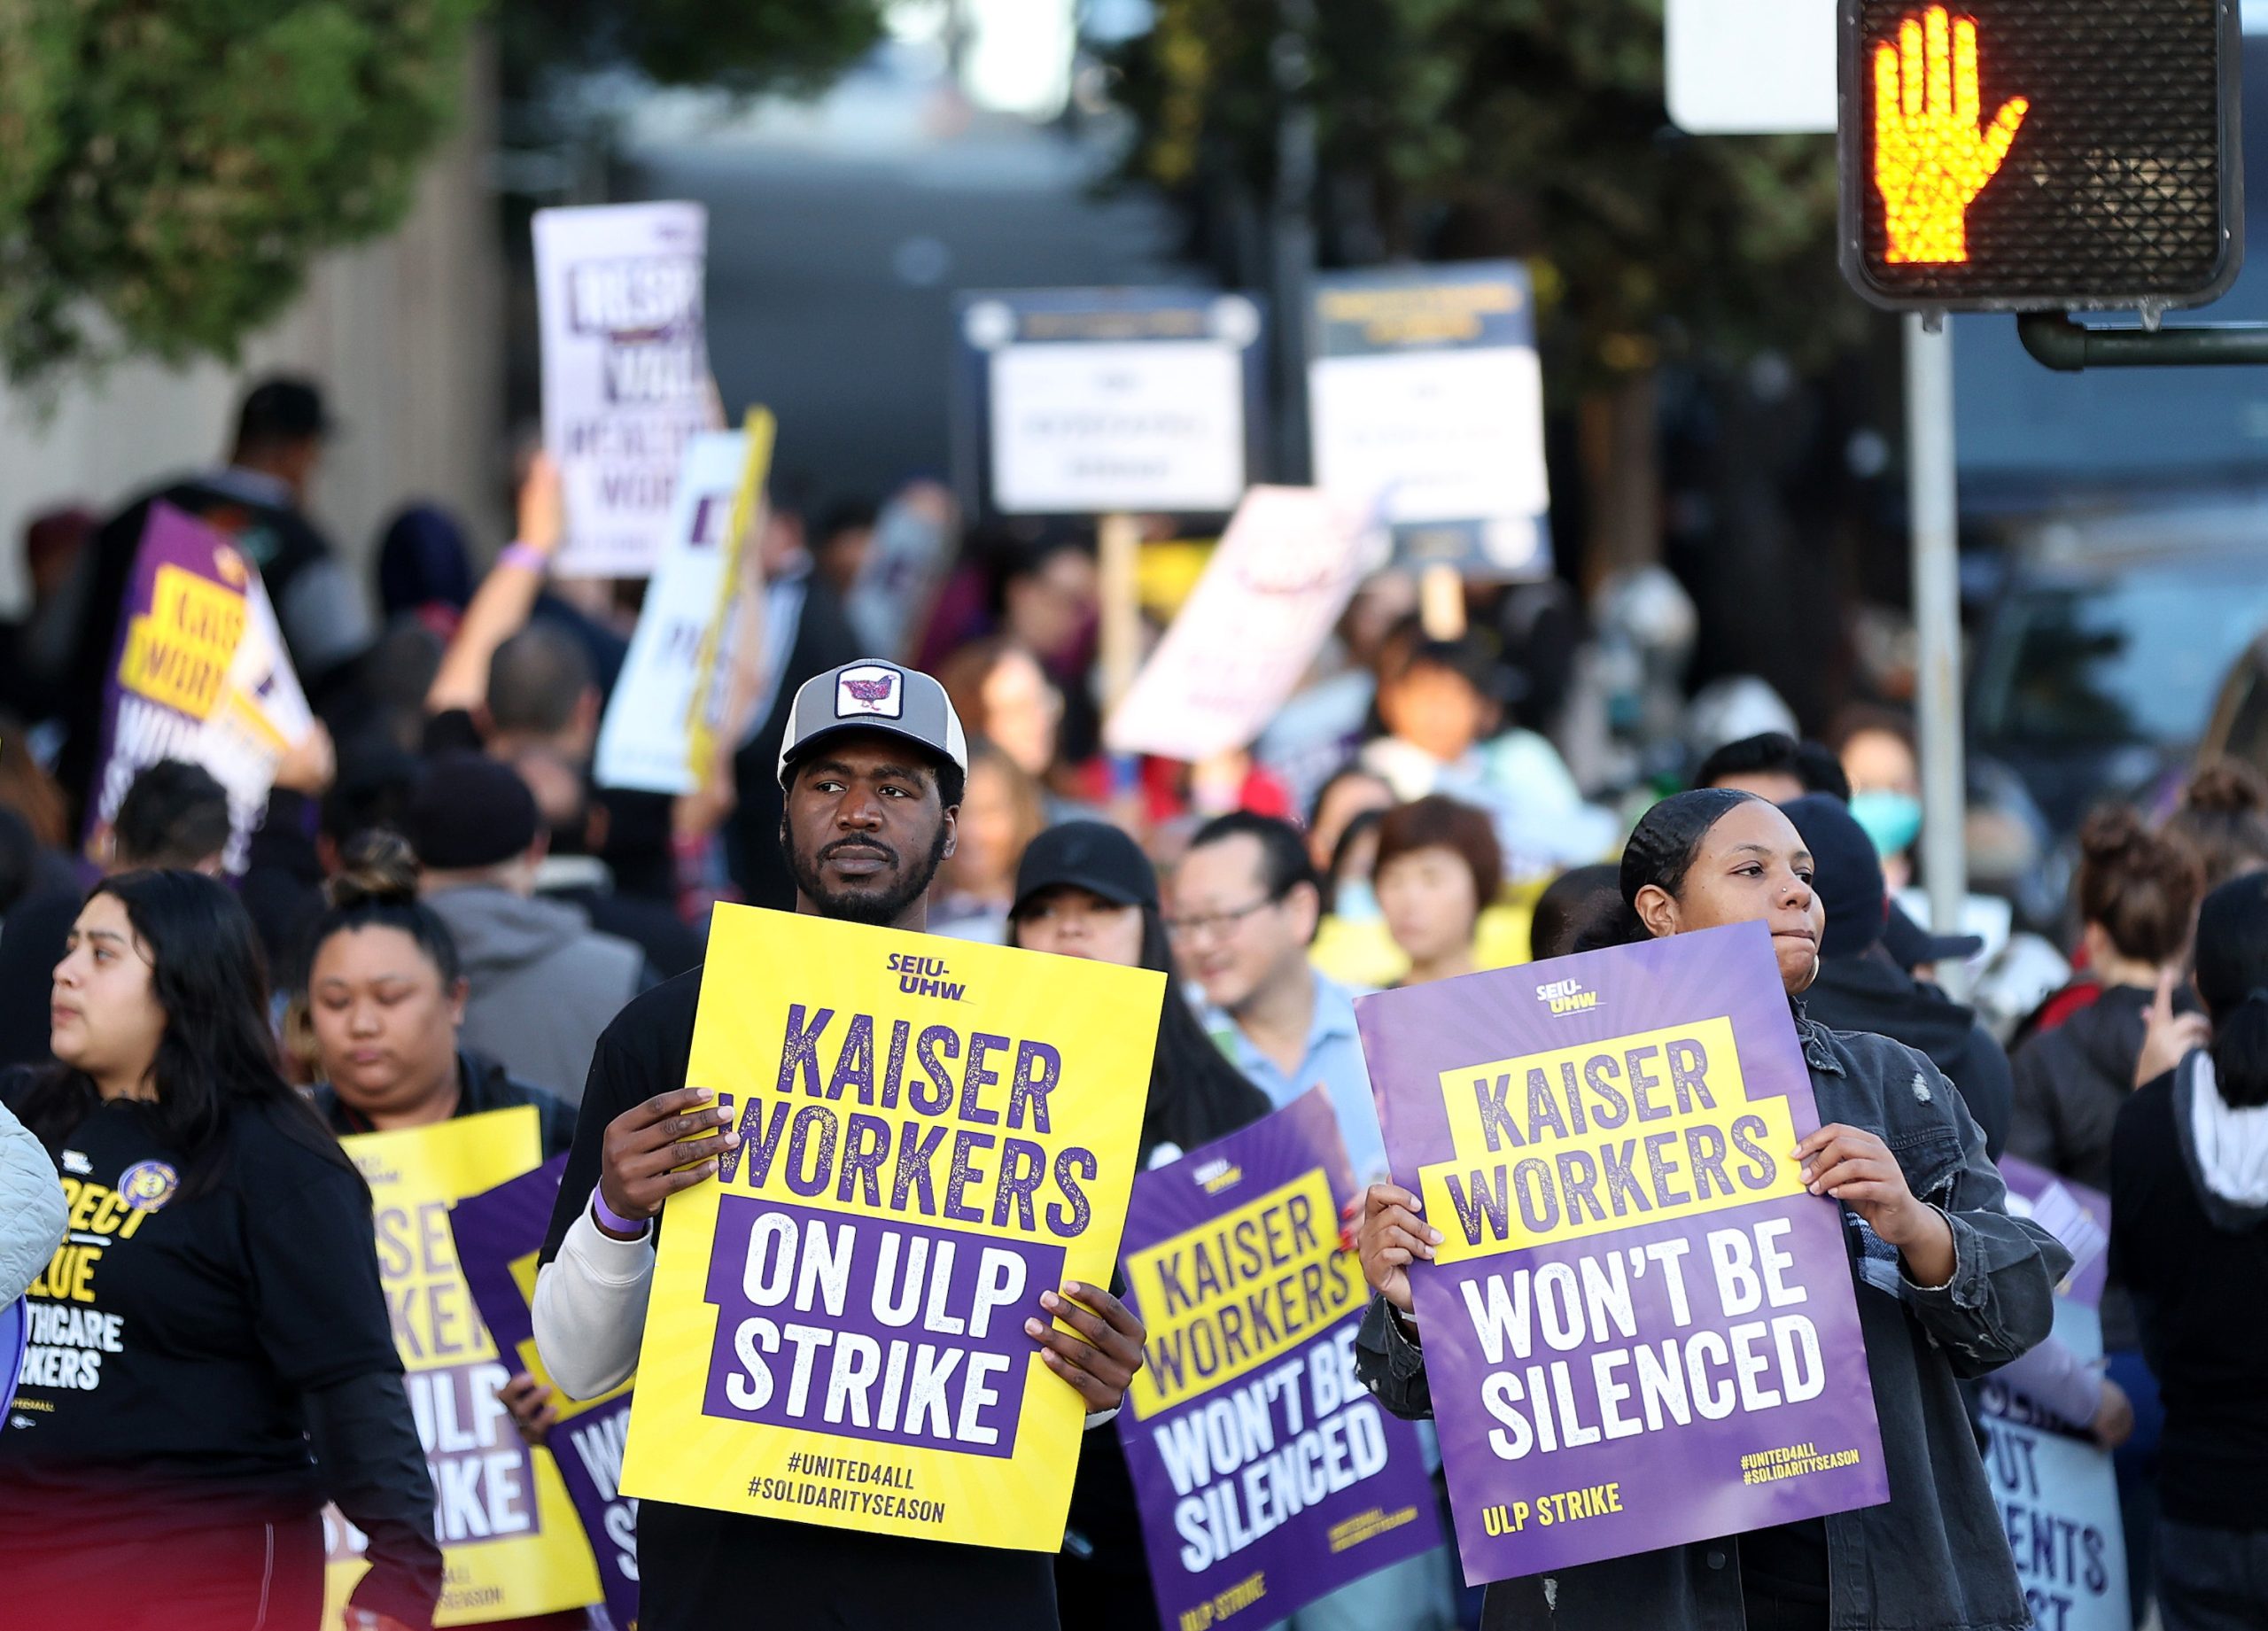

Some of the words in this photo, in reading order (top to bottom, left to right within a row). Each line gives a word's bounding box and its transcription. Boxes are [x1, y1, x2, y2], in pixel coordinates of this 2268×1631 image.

[887, 953, 950, 977] SEIU-
[899, 975, 966, 1001] UHW
[1535, 979, 1582, 1001] SEIU-
[1550, 991, 1596, 1014] UHW
[775, 1003, 1062, 1134] KAISER
[1473, 1037, 1718, 1152] KAISER
[718, 1092, 1097, 1238] WORKERS
[1445, 1115, 1777, 1246] WORKERS
[742, 1211, 857, 1317] ON
[871, 1231, 1027, 1339] ULP
[1157, 1192, 1319, 1318] KAISER
[1459, 1238, 1691, 1364] WON'T
[1705, 1217, 1808, 1316] BE
[725, 1316, 1011, 1445] STRIKE
[1143, 1262, 1352, 1398] WORKERS
[1481, 1314, 1826, 1461] SILENCED
[787, 1452, 915, 1490] #UNITED4ALL
[1154, 1358, 1304, 1495] WON'T
[1308, 1323, 1370, 1416] BE
[1740, 1442, 1818, 1471] #UNITED4ALL
[1743, 1448, 1860, 1486] #SOLIDARITYSEASON
[747, 1476, 945, 1524] #SOLIDARITYSEASON
[1174, 1402, 1388, 1573] SILENCED
[1483, 1503, 1529, 1537] ULP
[1537, 1482, 1623, 1528] STRIKE
